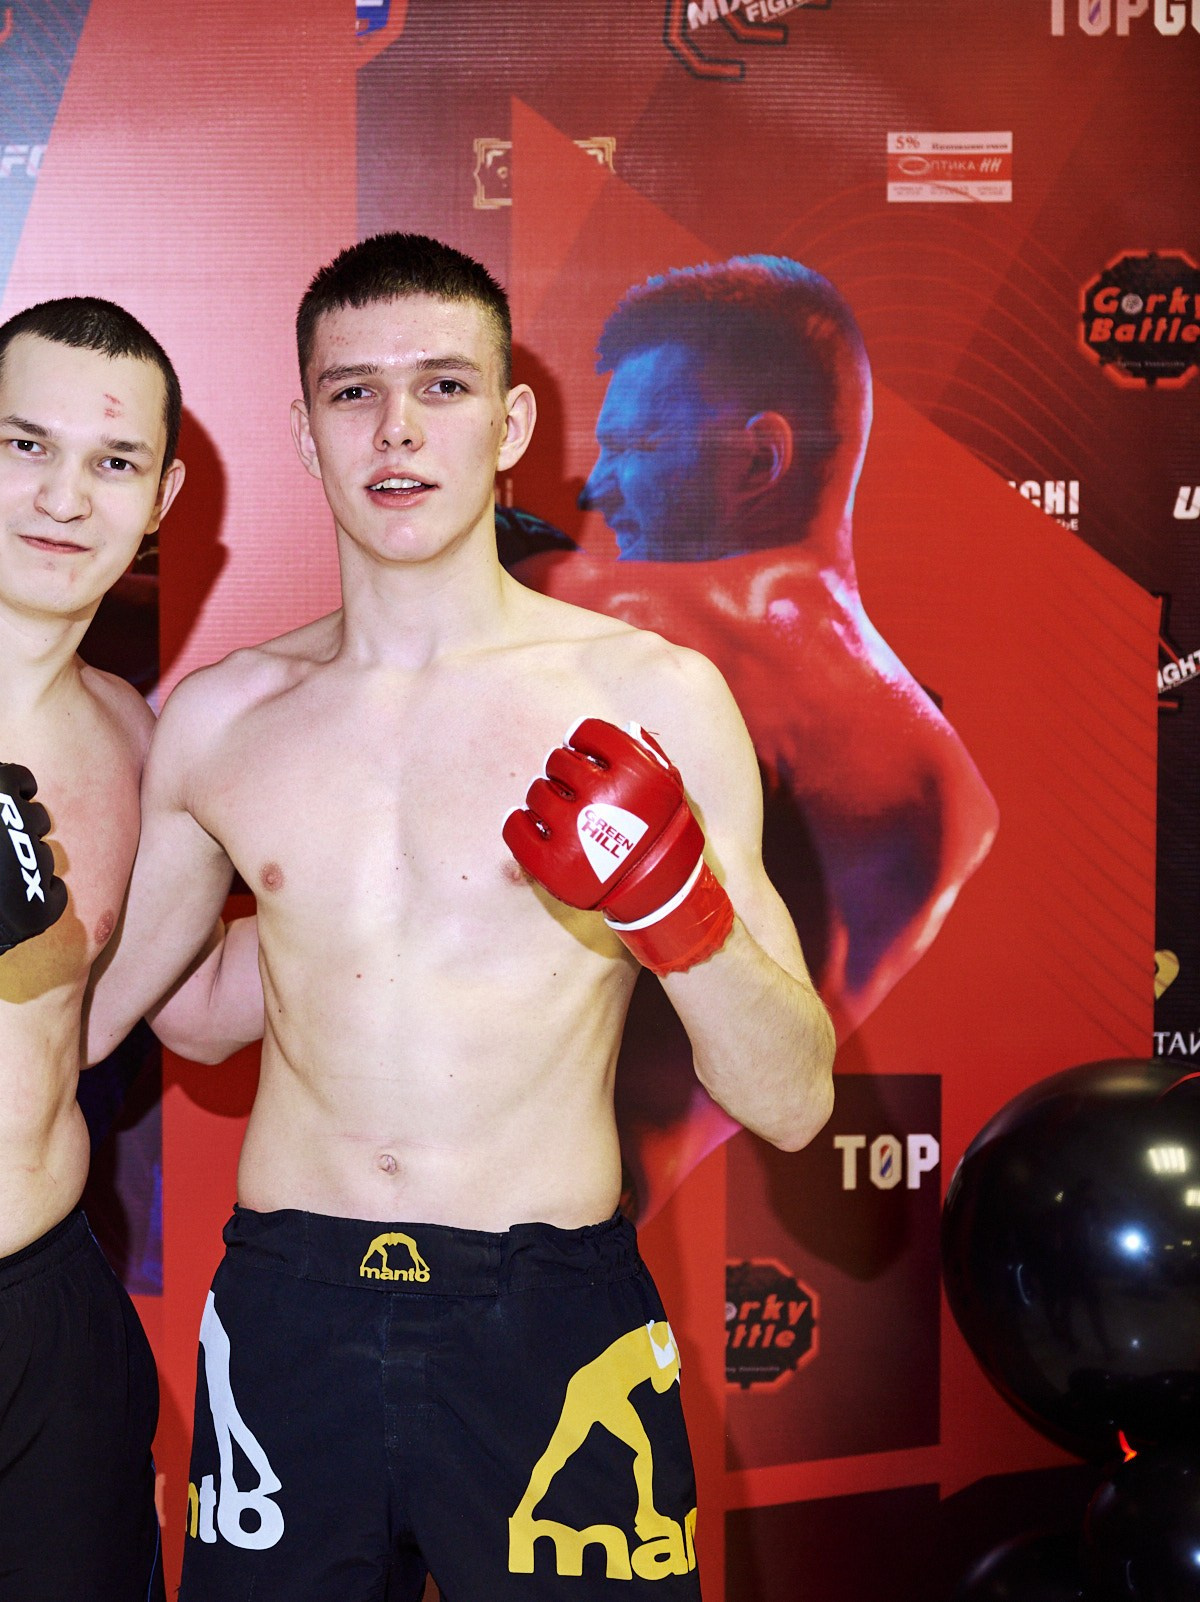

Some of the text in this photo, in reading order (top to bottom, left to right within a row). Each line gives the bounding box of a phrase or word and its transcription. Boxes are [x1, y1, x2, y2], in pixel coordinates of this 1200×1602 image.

[581, 824, 621, 859] HILL
[584, 808, 635, 851] GREEN
[834, 1134, 940, 1190] TOP
[360, 1266, 431, 1283] manto
